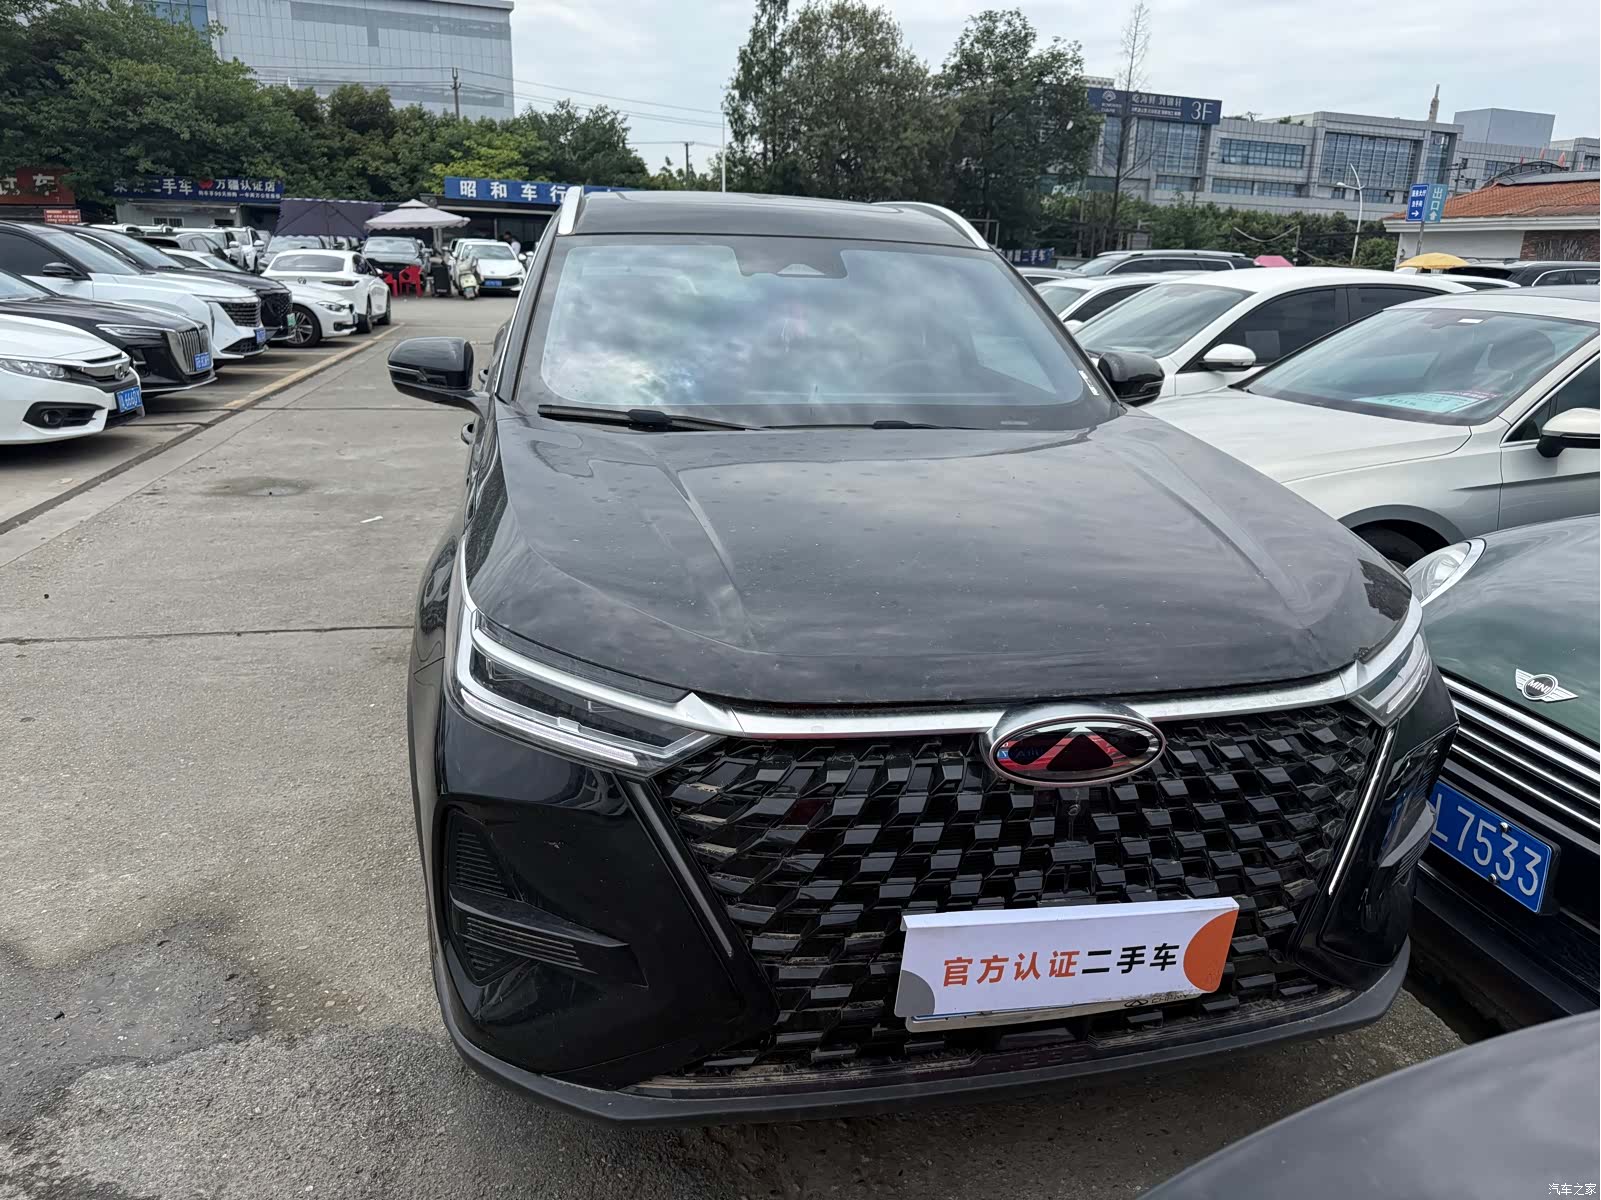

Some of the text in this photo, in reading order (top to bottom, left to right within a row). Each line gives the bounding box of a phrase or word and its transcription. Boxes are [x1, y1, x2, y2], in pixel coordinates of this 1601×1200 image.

[1190, 101, 1213, 121] 3F
[215, 179, 276, 192] 万疆认证店
[459, 180, 568, 203] 昭和车行
[1430, 187, 1443, 211] 出口
[1527, 679, 1551, 695] MINI
[943, 943, 1180, 987] 官方认证二手车
